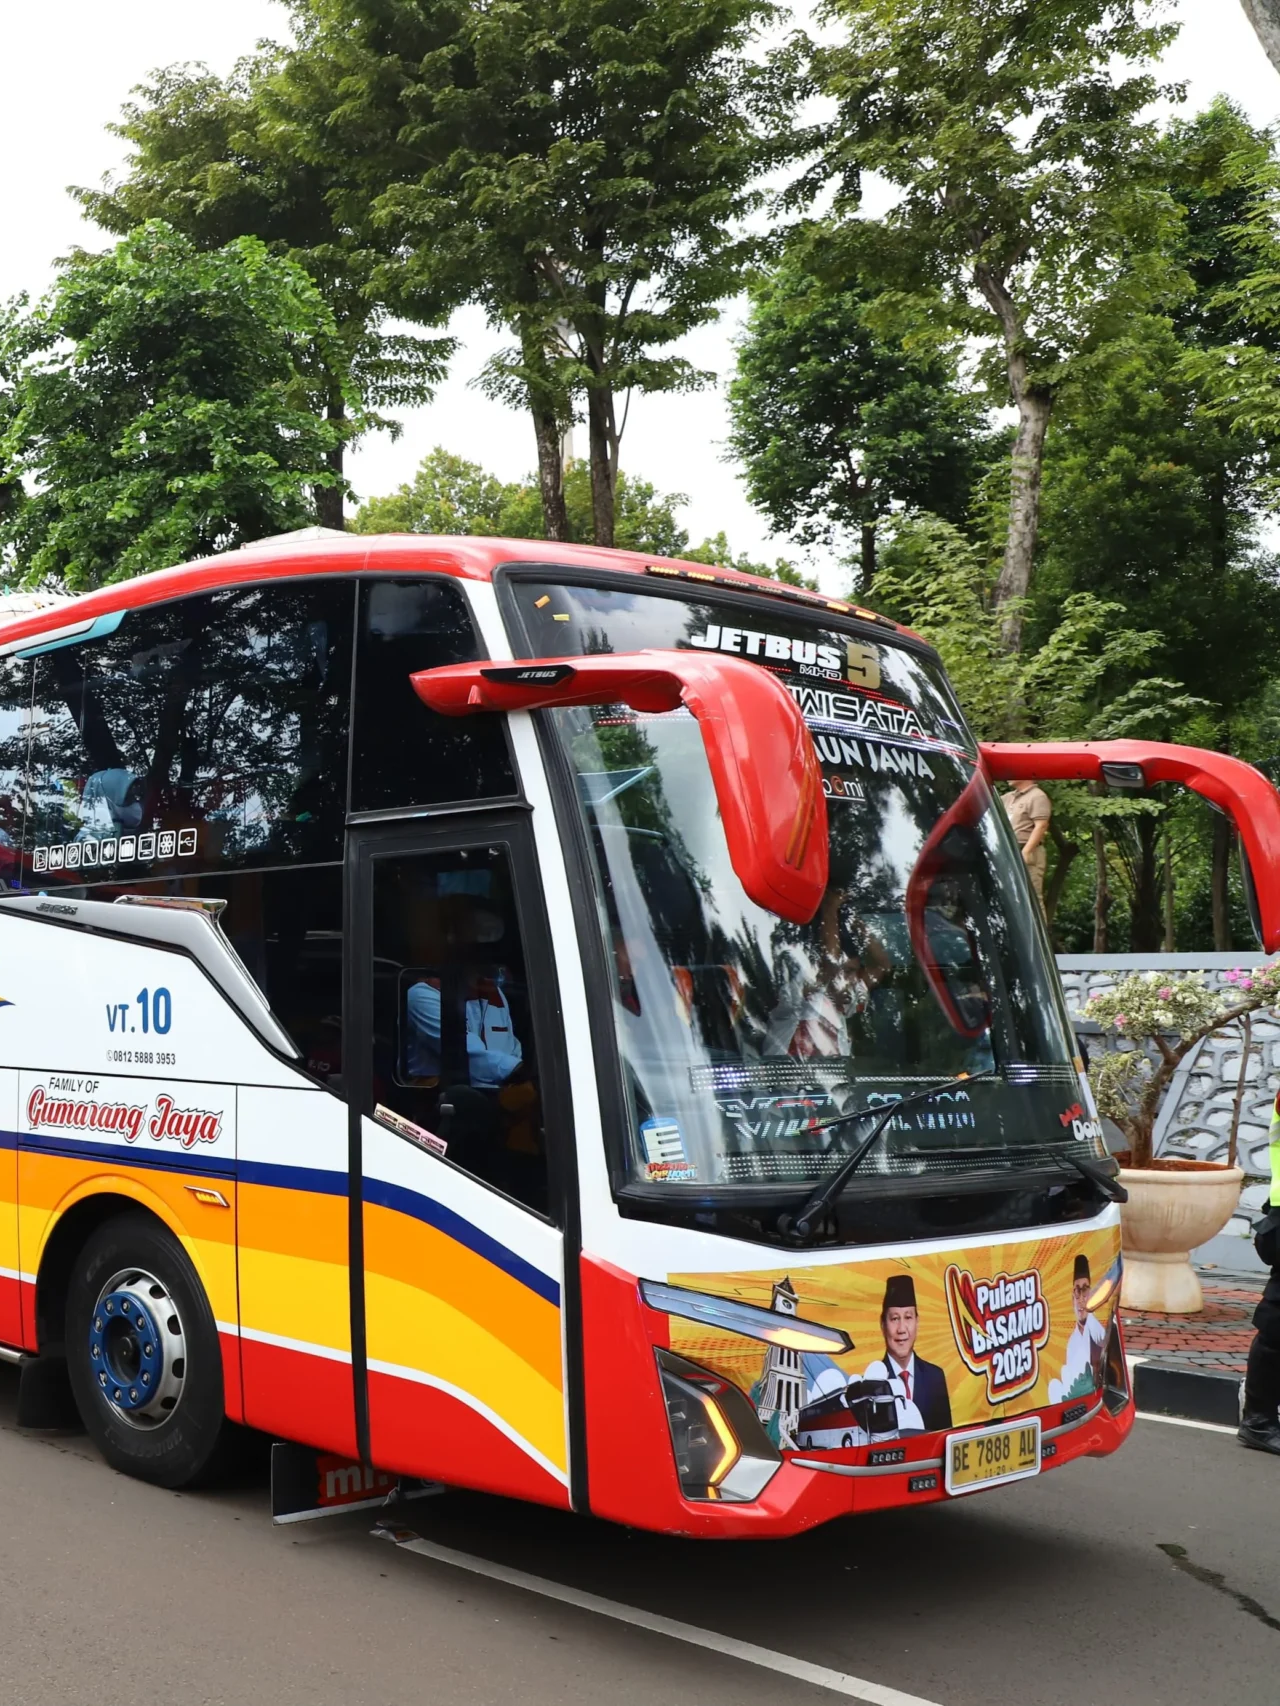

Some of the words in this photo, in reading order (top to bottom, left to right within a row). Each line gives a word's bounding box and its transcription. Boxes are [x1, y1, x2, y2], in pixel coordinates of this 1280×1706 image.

[517, 670, 558, 679] JETBUS
[691, 625, 841, 670] JETBUS
[846, 642, 880, 690] 5
[799, 664, 842, 681] MHD
[786, 685, 929, 740] WISATA
[865, 742, 936, 780] JAWA
[106, 987, 172, 1035] VT.10
[113, 1050, 133, 1063] 0812
[134, 1051, 154, 1064] 5888
[156, 1052, 176, 1065] 3953
[48, 1076, 83, 1093] FAMILY
[85, 1080, 100, 1094] OF
[28, 1086, 147, 1142] Gumarang
[150, 1095, 223, 1148] Jaya
[977, 1275, 1035, 1314] Pulang
[971, 1302, 1044, 1355] BASAMO
[992, 1339, 1032, 1386] 2025
[953, 1443, 969, 1472] BE
[977, 1434, 1010, 1467] 7888
[1019, 1428, 1035, 1457] AU
